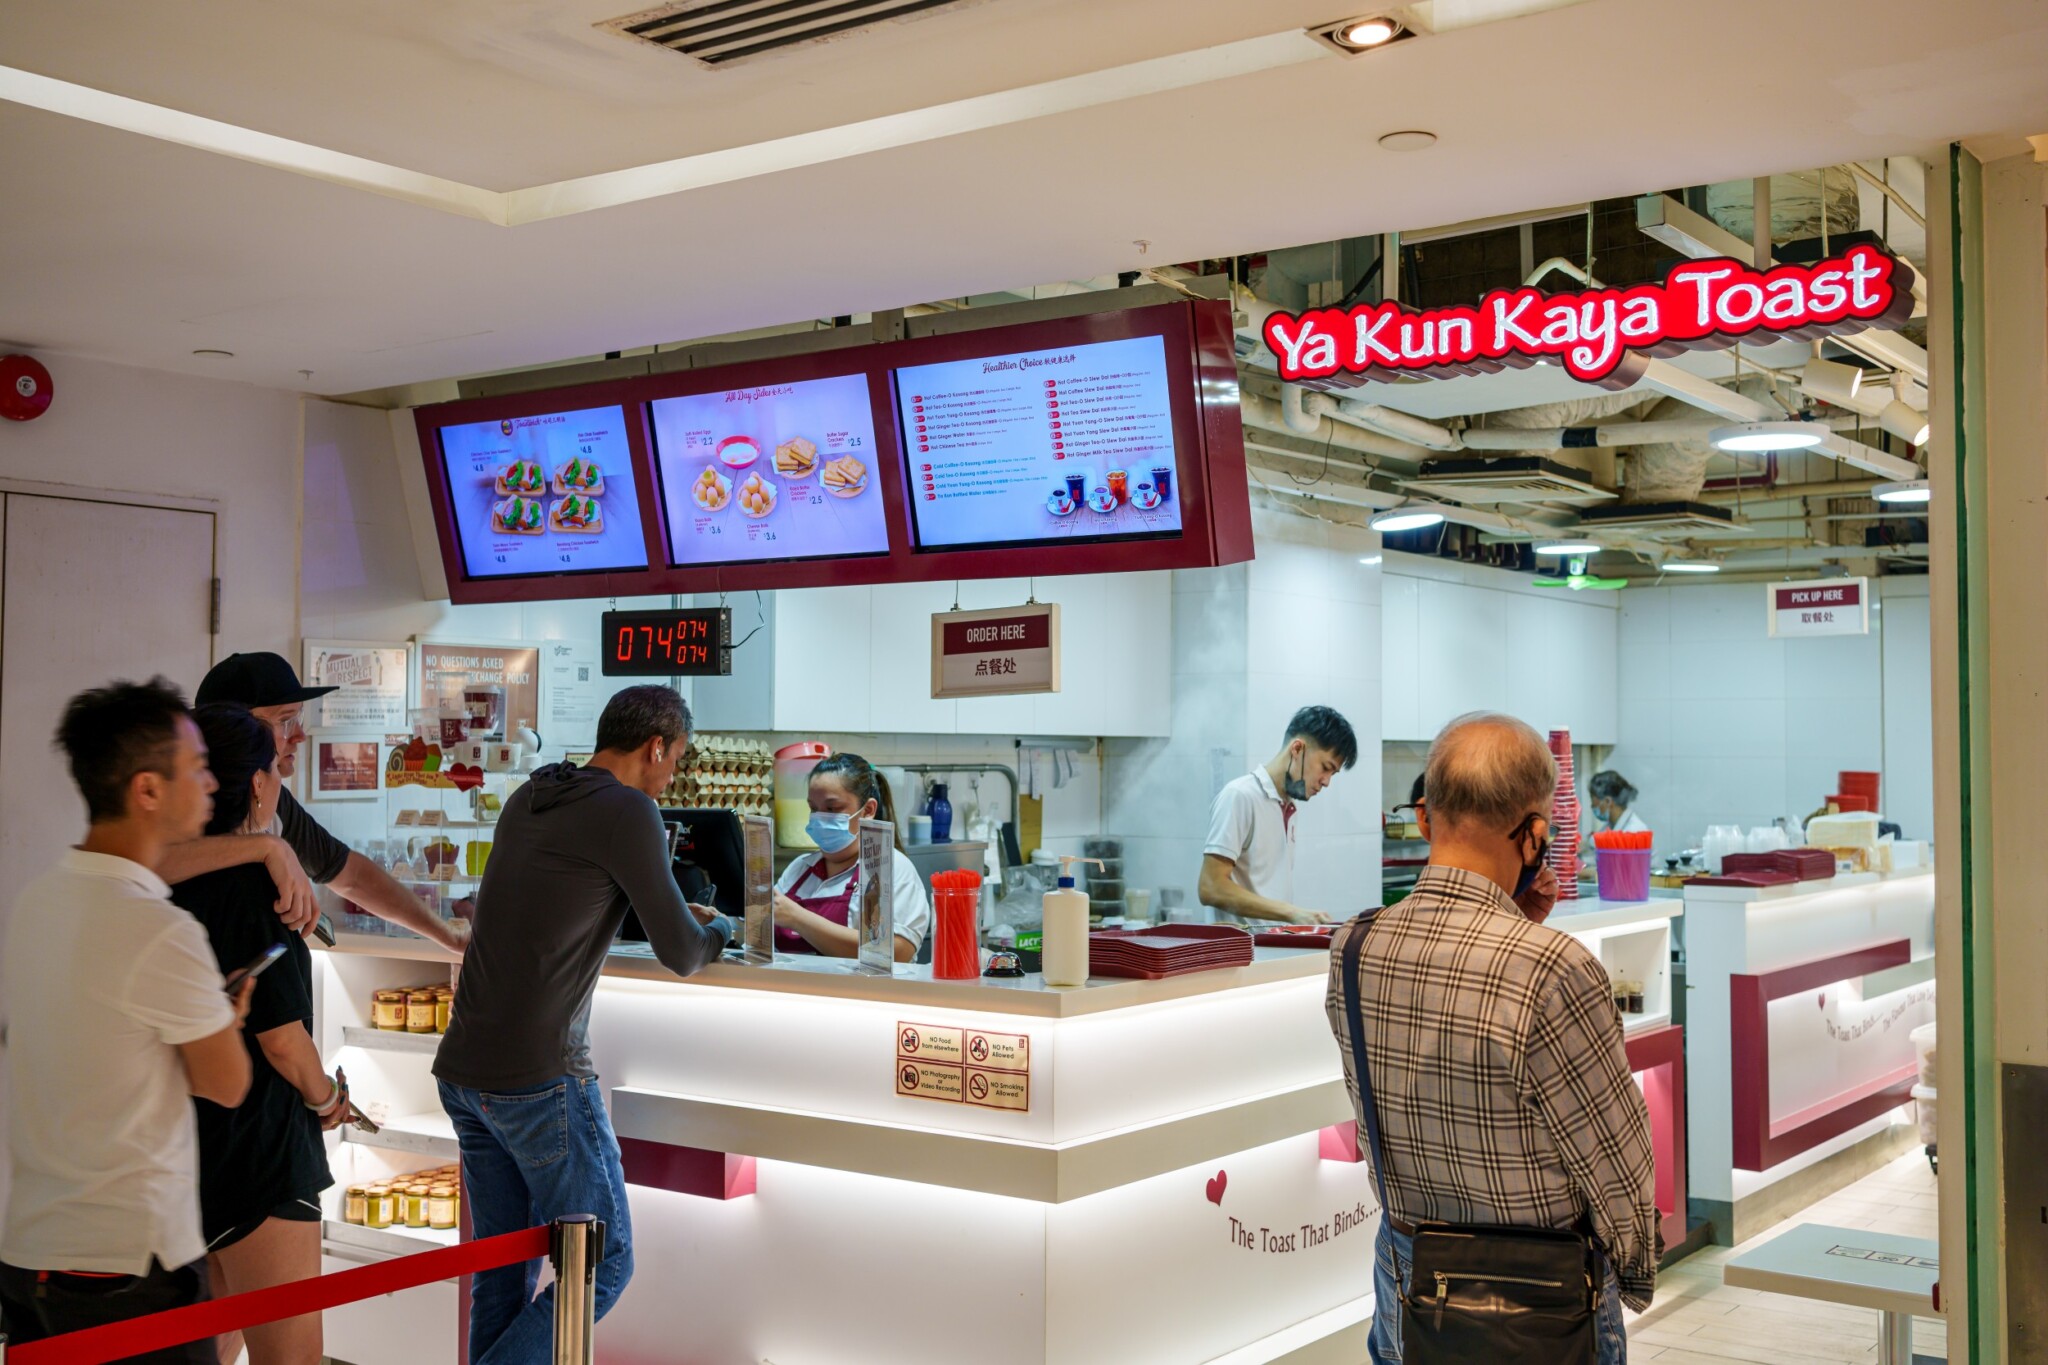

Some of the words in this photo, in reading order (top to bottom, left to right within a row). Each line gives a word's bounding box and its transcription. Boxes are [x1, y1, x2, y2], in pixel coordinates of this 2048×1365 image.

[1273, 320, 1336, 370] Ya
[1355, 312, 1472, 365] Kun
[1493, 294, 1659, 370] Kaya
[1676, 253, 1881, 327] Toast
[982, 360, 1017, 374] Healthier
[1020, 358, 1042, 370] Choice
[725, 392, 736, 402] All
[738, 390, 751, 404] Day
[753, 388, 770, 400] Sides
[1791, 592, 1809, 603] PICK
[1811, 591, 1822, 602] UP
[1823, 589, 1843, 600] HERE
[1801, 611, 1834, 623] 取餐处
[677, 621, 707, 639] 074
[966, 626, 998, 643] ORDER
[1001, 624, 1025, 640] HERE
[617, 626, 672, 660] 074
[426, 655, 436, 666] NO
[441, 656, 480, 668] QUESTIONS
[482, 658, 504, 669] ASKED
[677, 646, 707, 664] 074
[326, 657, 360, 674] MUTUAL
[975, 657, 1017, 676] 点餐处
[338, 666, 372, 683] RESPECT
[507, 672, 530, 684] POLICY
[934, 1044, 959, 1052] elsewhere
[992, 1051, 1014, 1059] Allowed
[929, 1071, 960, 1081] Photography
[936, 1084, 961, 1094] Recording
[1000, 1082, 1024, 1092] Smoking
[1229, 1216, 1254, 1250] The
[1260, 1228, 1295, 1253] Toast
[1301, 1224, 1329, 1248] That
